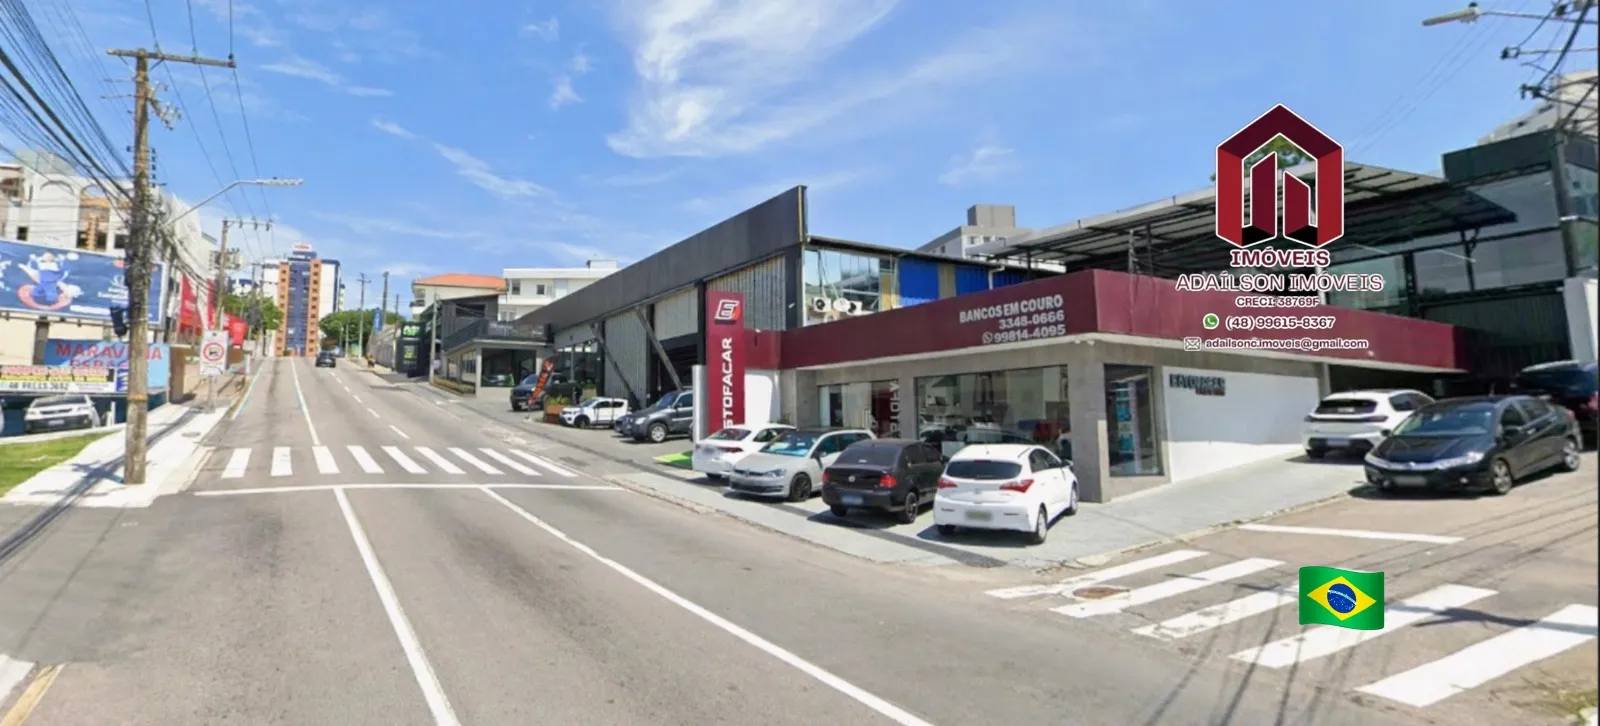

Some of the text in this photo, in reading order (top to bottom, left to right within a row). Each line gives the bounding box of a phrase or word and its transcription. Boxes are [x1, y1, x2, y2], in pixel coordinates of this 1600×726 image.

[960, 294, 1064, 324] BANCOS EM COURO
[998, 310, 1065, 330] 3348-0666
[994, 324, 1066, 343] 99814-4095
[721, 337, 734, 430] STOFACAR
